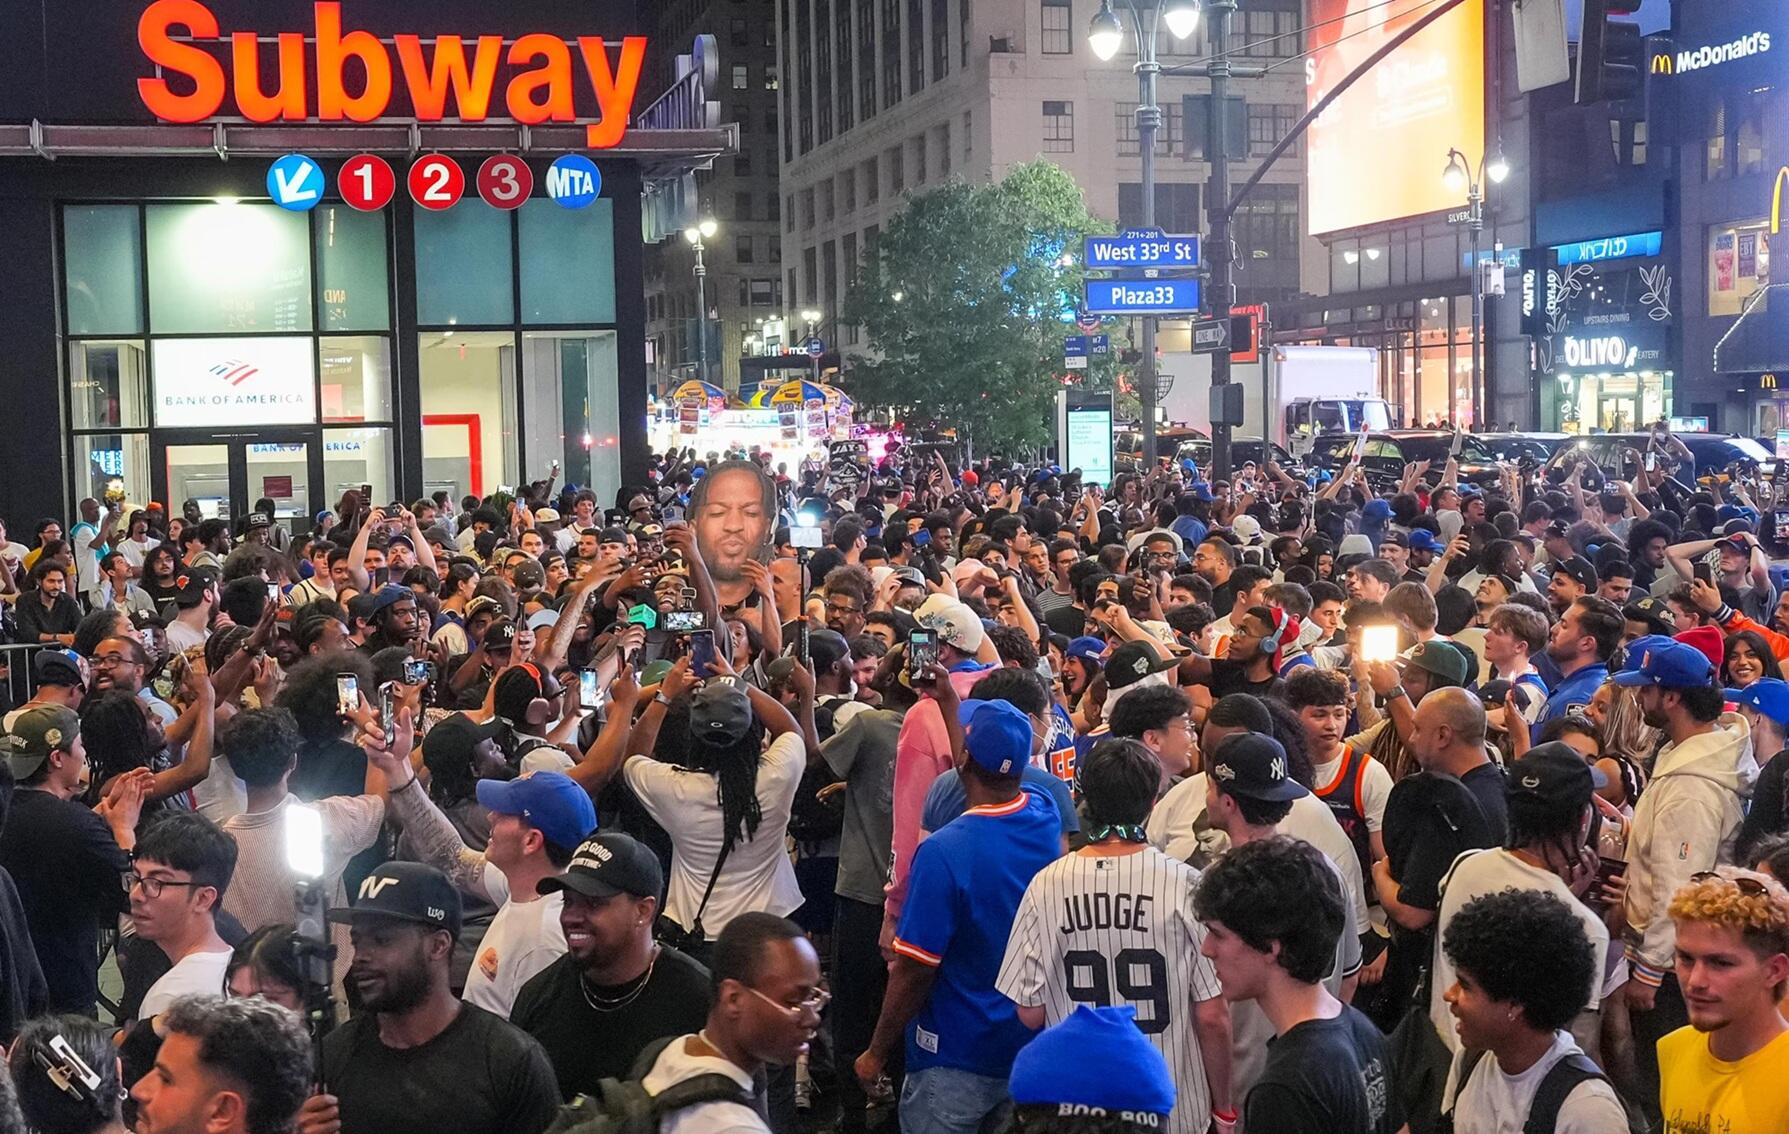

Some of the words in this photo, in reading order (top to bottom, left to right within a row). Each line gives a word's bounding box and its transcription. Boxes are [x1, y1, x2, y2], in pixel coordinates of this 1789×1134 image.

[1676, 32, 1770, 74] McDonald's
[138, 0, 647, 148] Subway
[353, 164, 373, 201] 1
[423, 164, 452, 201] 2
[490, 163, 520, 200] 3
[546, 165, 594, 199] MTA
[1094, 243, 1137, 261] West
[1140, 241, 1170, 260] 33rd
[1174, 242, 1191, 260] St
[1111, 286, 1174, 305] Plaza33
[1637, 350, 1659, 360] EATERY
[165, 395, 206, 406] BANK
[212, 394, 230, 405] OF
[235, 394, 304, 405] AMERICA
[326, 442, 361, 451] ERICA
[589, 842, 613, 862] GOOD
[1060, 892, 1154, 935] JUDGE
[1063, 948, 1171, 1035] 99
